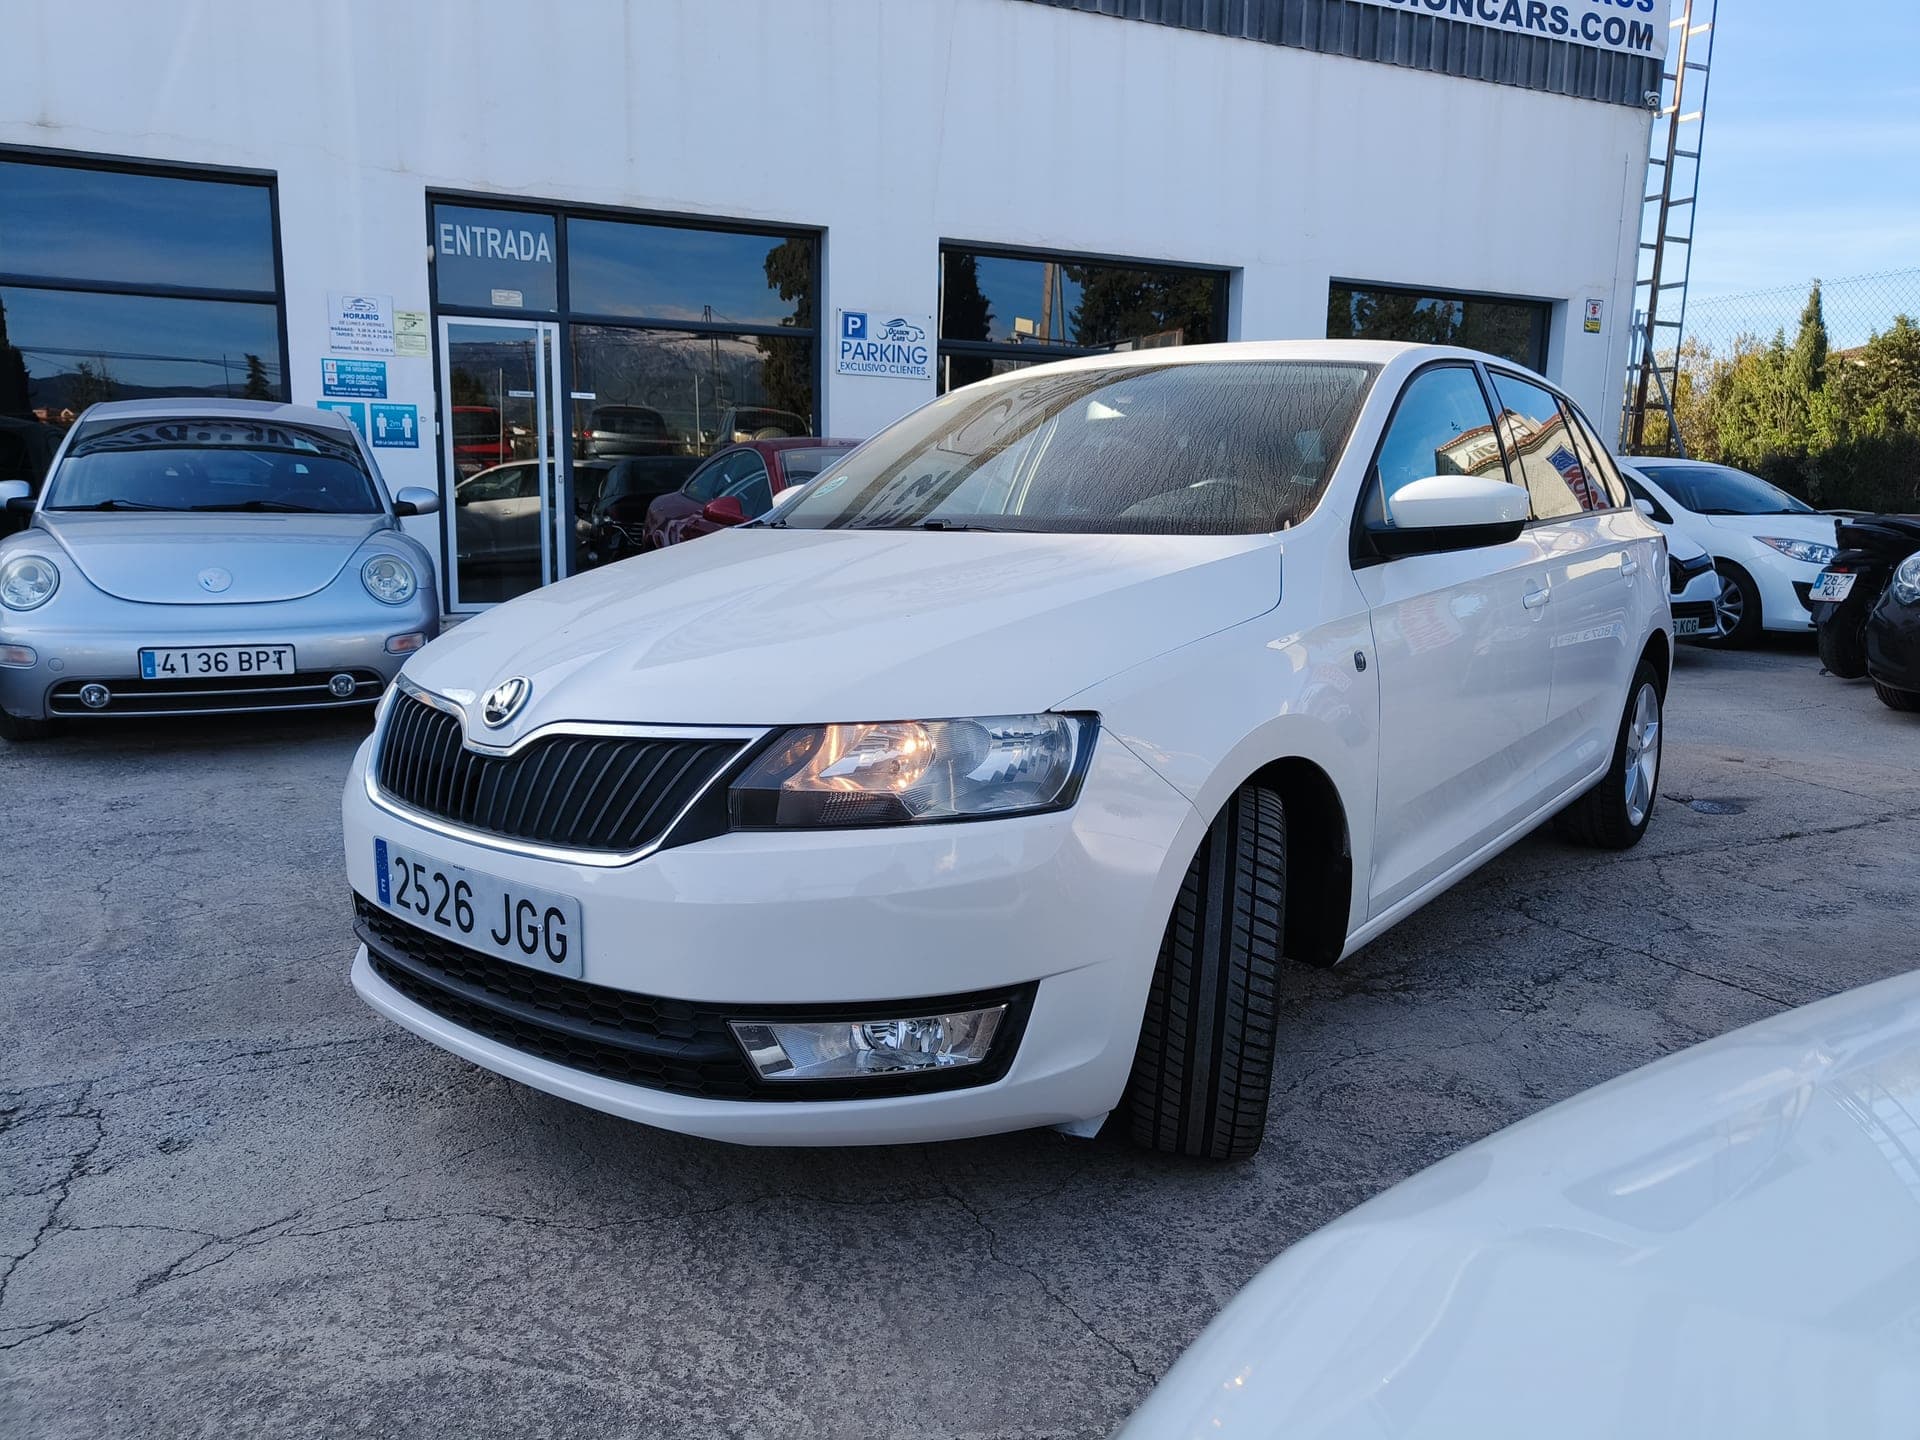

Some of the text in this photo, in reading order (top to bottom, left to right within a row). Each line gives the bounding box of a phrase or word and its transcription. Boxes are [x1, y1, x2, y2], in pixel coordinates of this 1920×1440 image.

[1389, 0, 1653, 51] NCARS.COM
[440, 223, 552, 263] ENTRADA
[343, 312, 379, 321] HORARIO
[848, 316, 861, 335] P
[841, 341, 928, 365] PARKING
[840, 362, 926, 375] EXCLUSIVO CLIENTES
[1823, 574, 1854, 586] 2827
[161, 652, 229, 674] 4136
[238, 650, 287, 672] BPT
[395, 857, 475, 934] 2526
[491, 893, 568, 964] JGG
